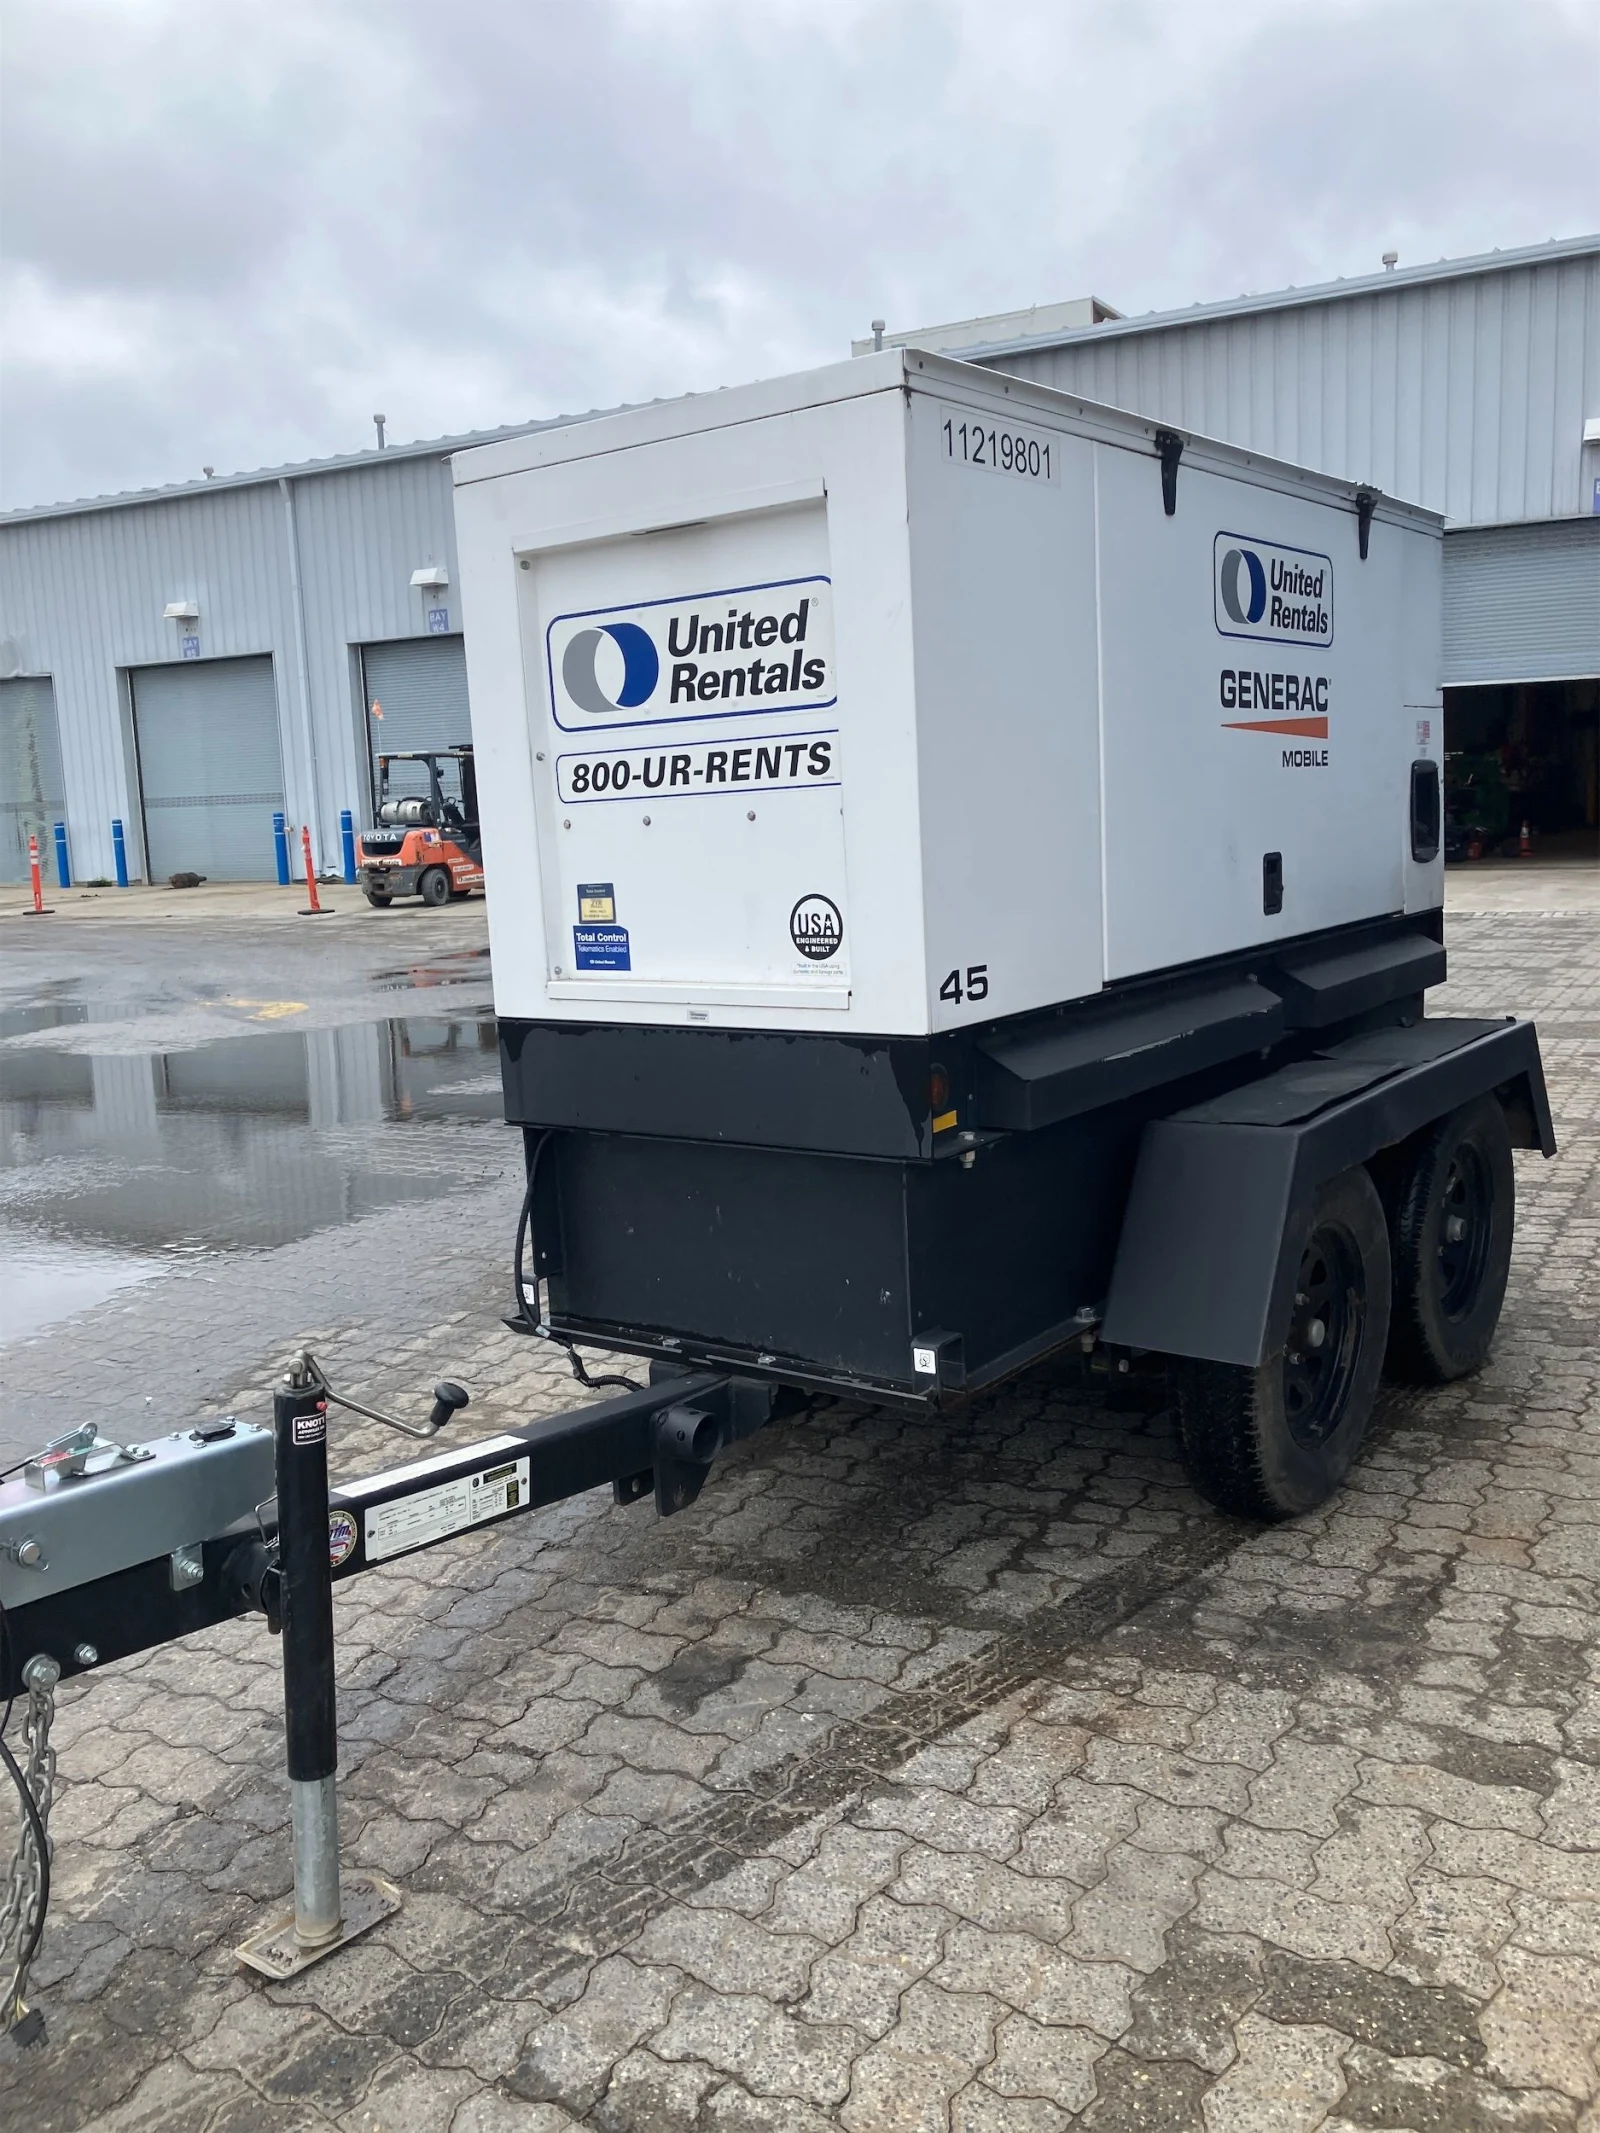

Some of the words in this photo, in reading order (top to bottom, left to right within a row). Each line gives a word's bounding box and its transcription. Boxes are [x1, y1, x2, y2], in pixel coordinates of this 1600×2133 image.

[943, 418, 1051, 480] 11219801
[1270, 558, 1324, 599] United
[429, 611, 447, 622] BAY
[667, 598, 810, 658] United
[1269, 595, 1329, 635] Rentals
[669, 647, 826, 704] Rentals
[1220, 669, 1329, 712] GENERAC
[571, 740, 832, 794] 800-UR-RENTS
[1282, 750, 1329, 768] MOBILE
[363, 833, 398, 842] TOYOTA
[575, 932, 595, 942] Total
[597, 932, 627, 943] Control
[797, 913, 836, 935] USA
[577, 944, 605, 953] Telematics
[605, 945, 628, 954] Enabled
[795, 937, 839, 945] ENGINEERED
[811, 945, 831, 953] BUILT
[939, 963, 989, 1005] 45
